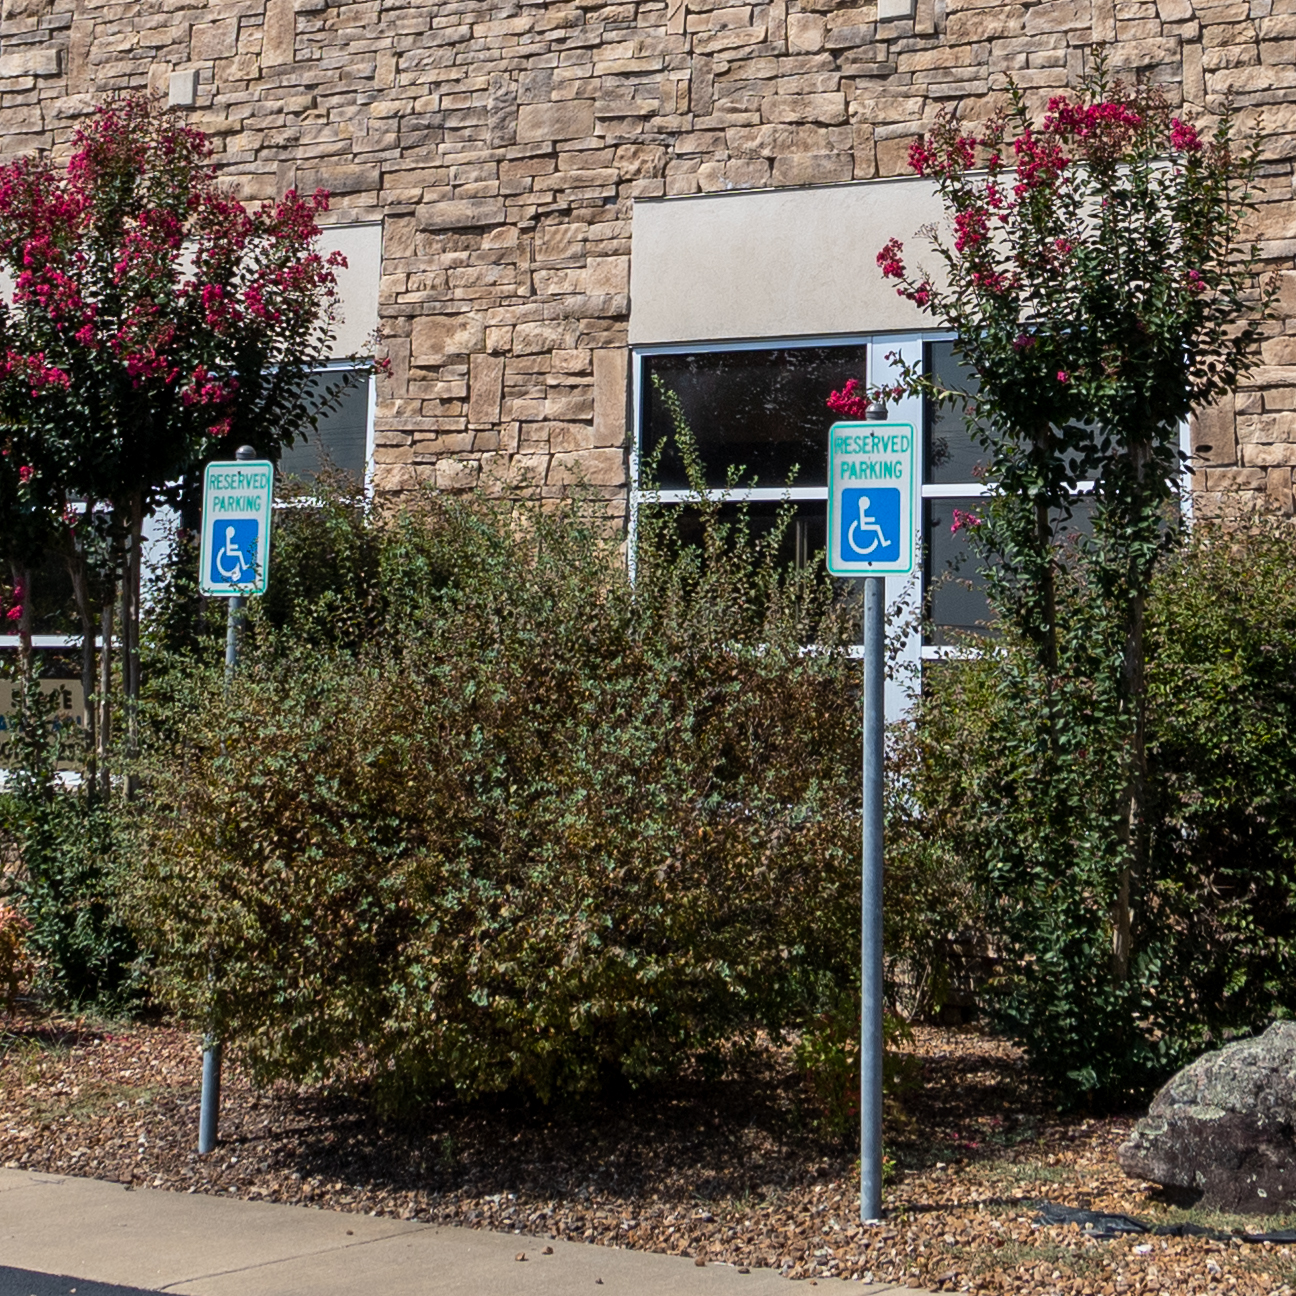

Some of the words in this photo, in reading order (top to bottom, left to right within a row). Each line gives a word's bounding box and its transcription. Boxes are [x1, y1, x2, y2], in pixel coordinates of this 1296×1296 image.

[834, 435, 910, 454] RESERVED
[841, 461, 902, 479] PARKING
[209, 473, 267, 490] RESERVED
[212, 495, 261, 513] PARKING
